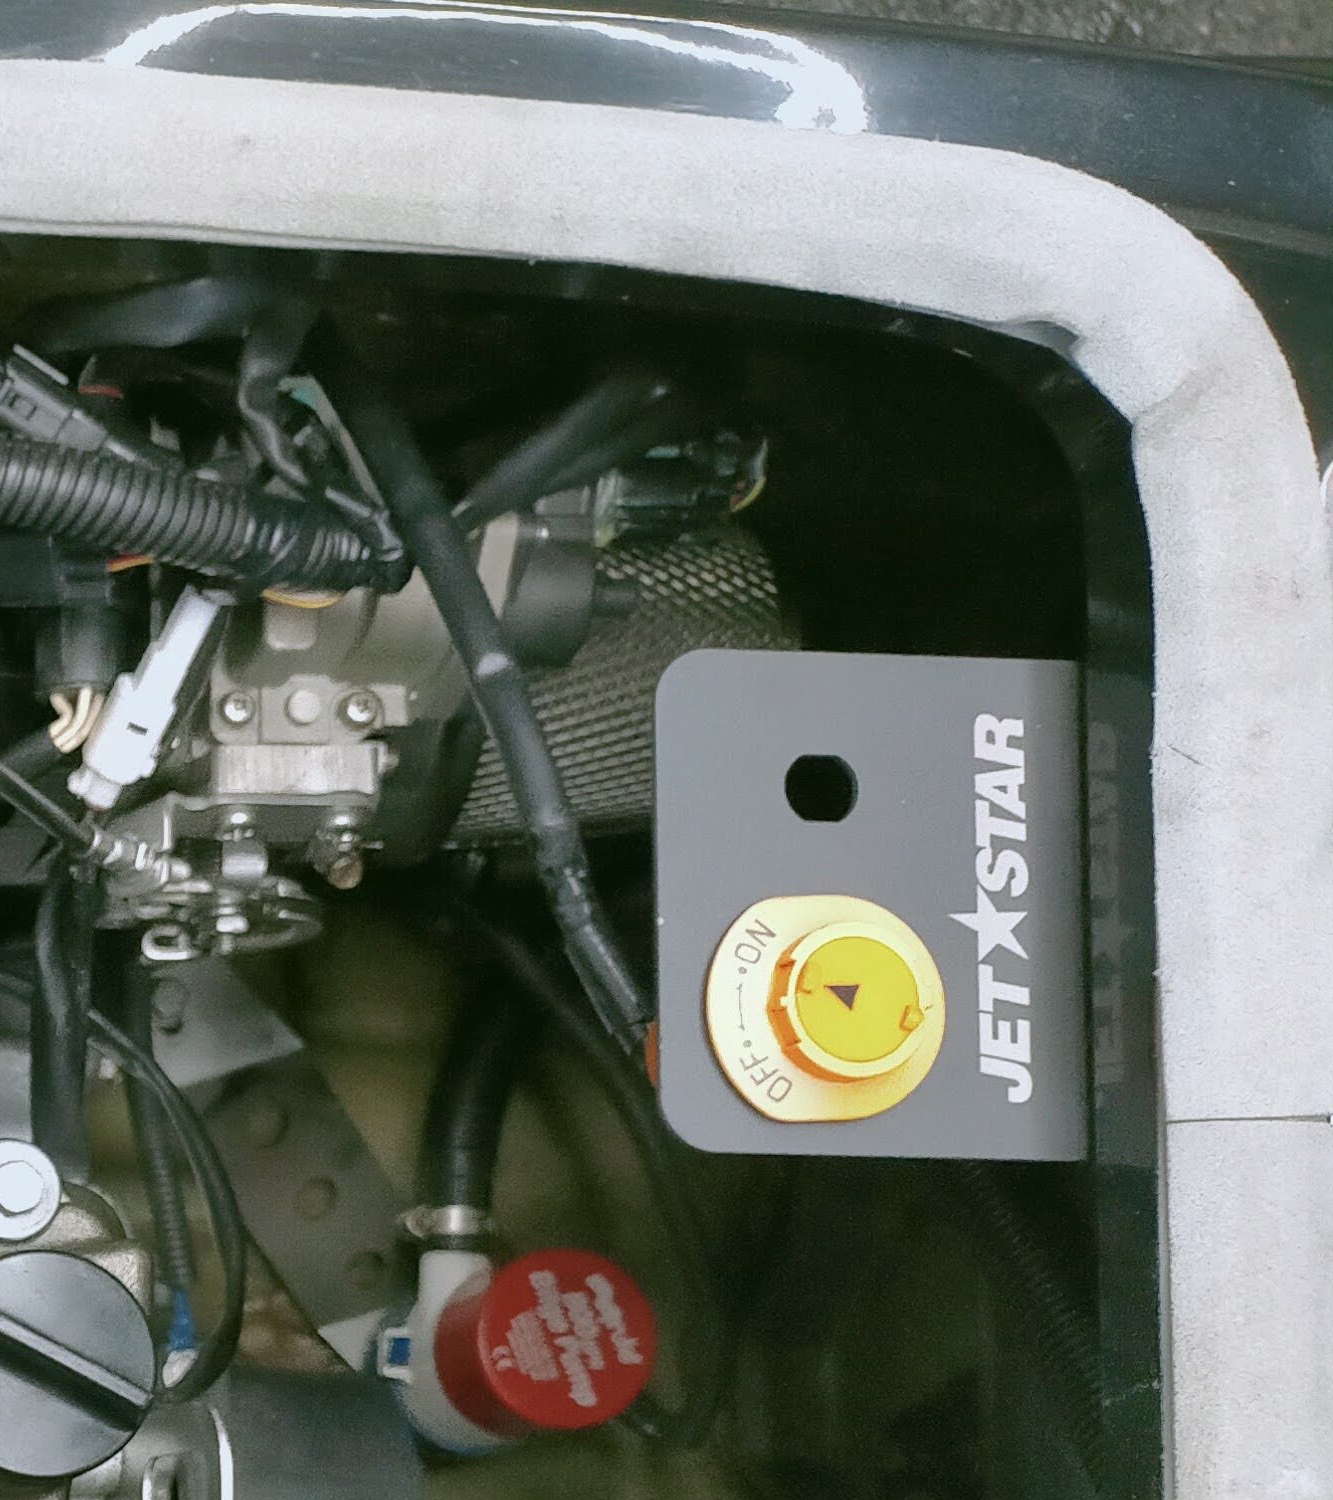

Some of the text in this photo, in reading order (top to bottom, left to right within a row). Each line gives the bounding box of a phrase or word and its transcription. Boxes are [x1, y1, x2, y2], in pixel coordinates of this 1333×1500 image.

[974, 713, 1033, 1104] JET STAR
[734, 919, 777, 964] ON
[740, 1053, 793, 1103] OFF
